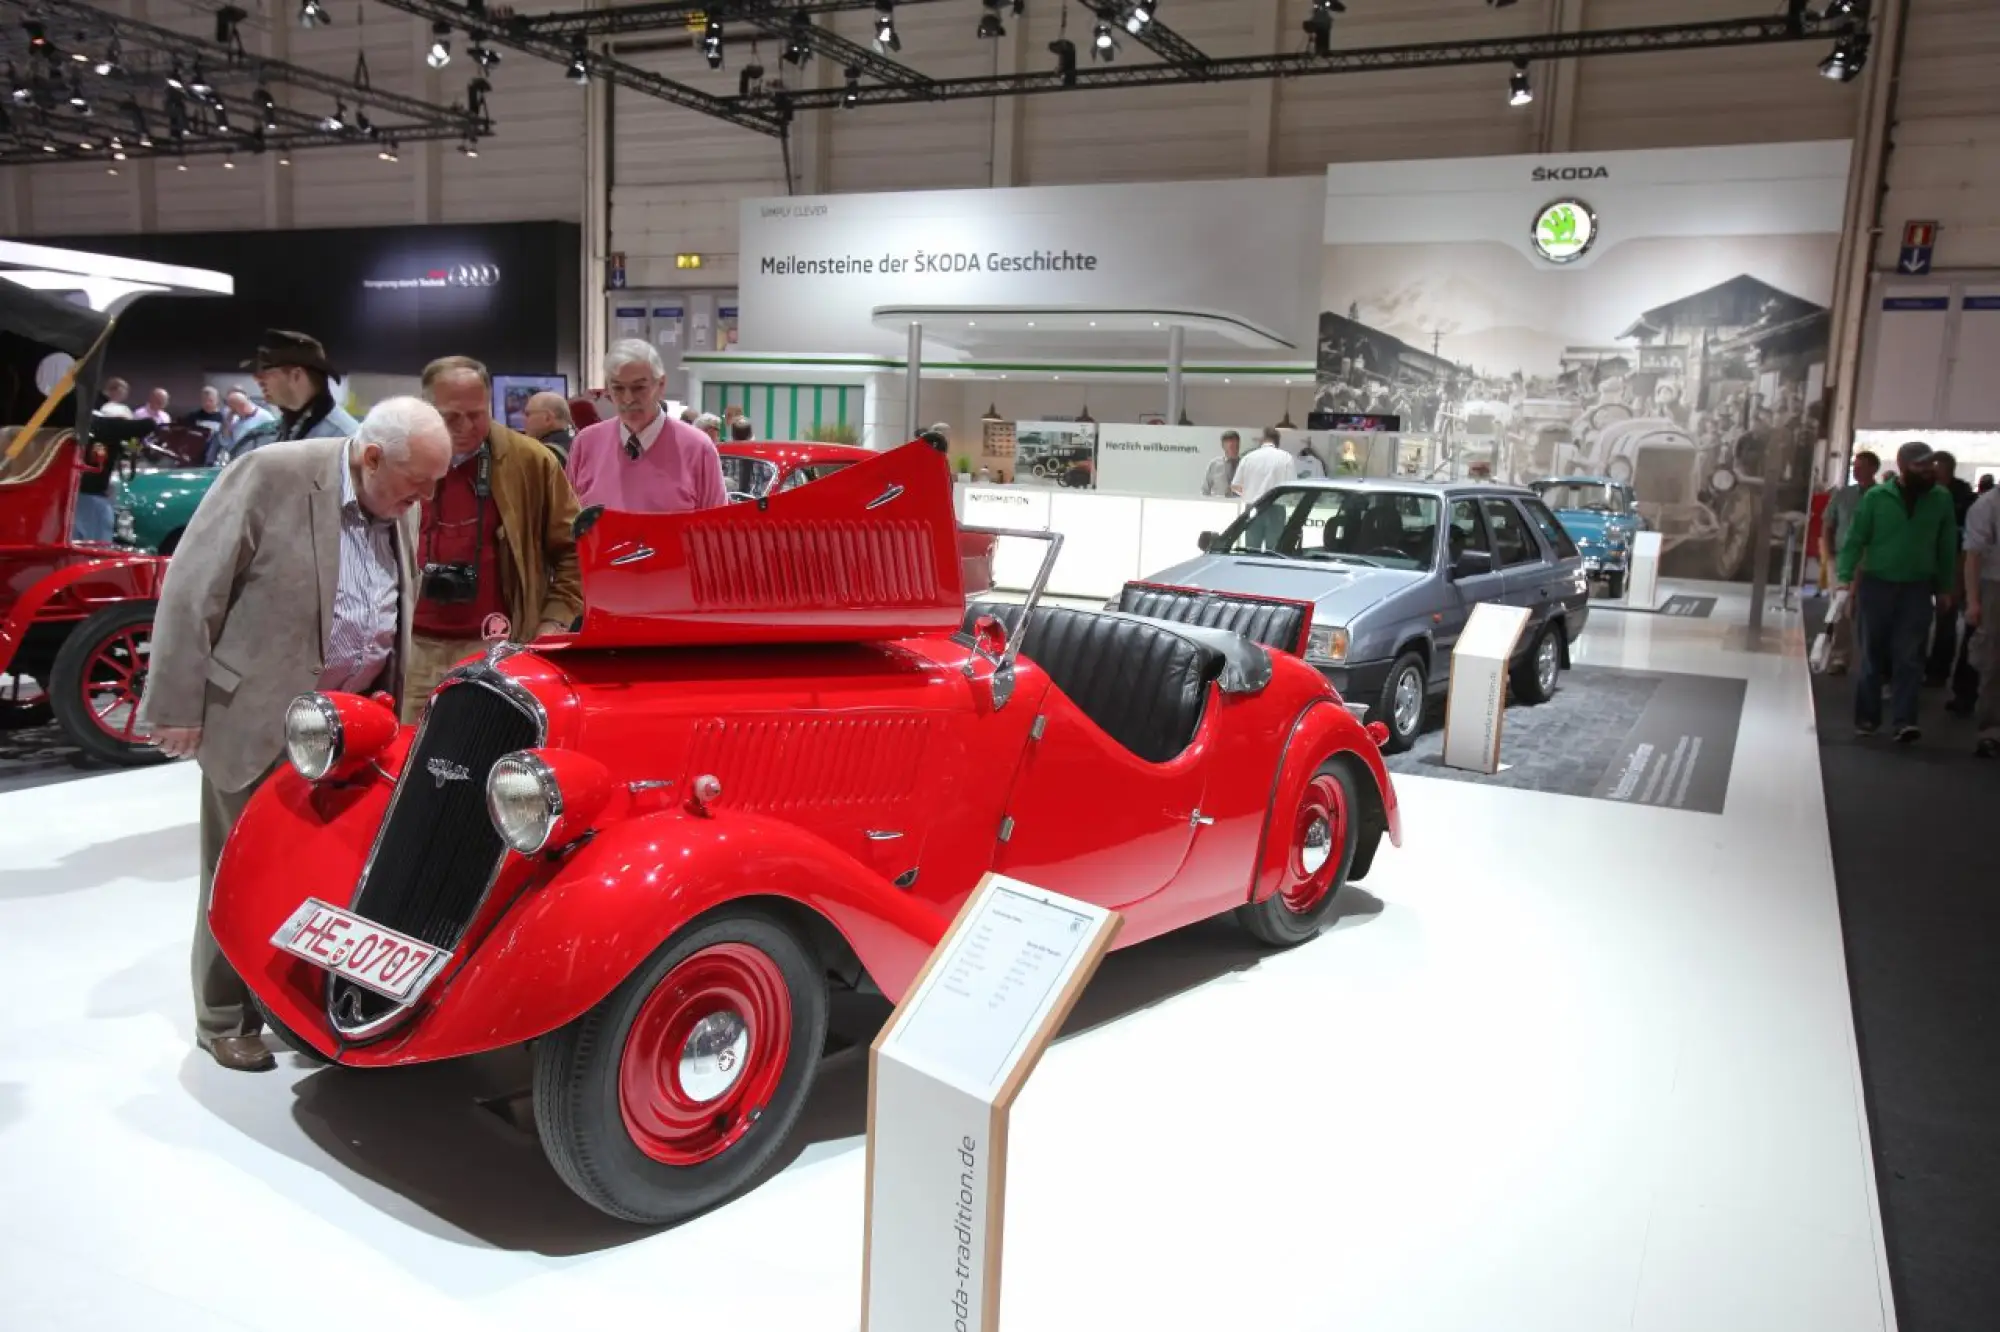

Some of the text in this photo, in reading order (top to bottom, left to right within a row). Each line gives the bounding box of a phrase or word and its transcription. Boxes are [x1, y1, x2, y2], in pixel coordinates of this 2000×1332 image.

[1531, 165, 1609, 181] ŠKODA
[760, 203, 828, 218] SIMPLY CLEVER
[761, 249, 1098, 275] Meilensteine der ŠKODA Geschichte
[1105, 440, 1200, 454] Herzlich willkommen.
[971, 493, 1029, 506] INFORMATION
